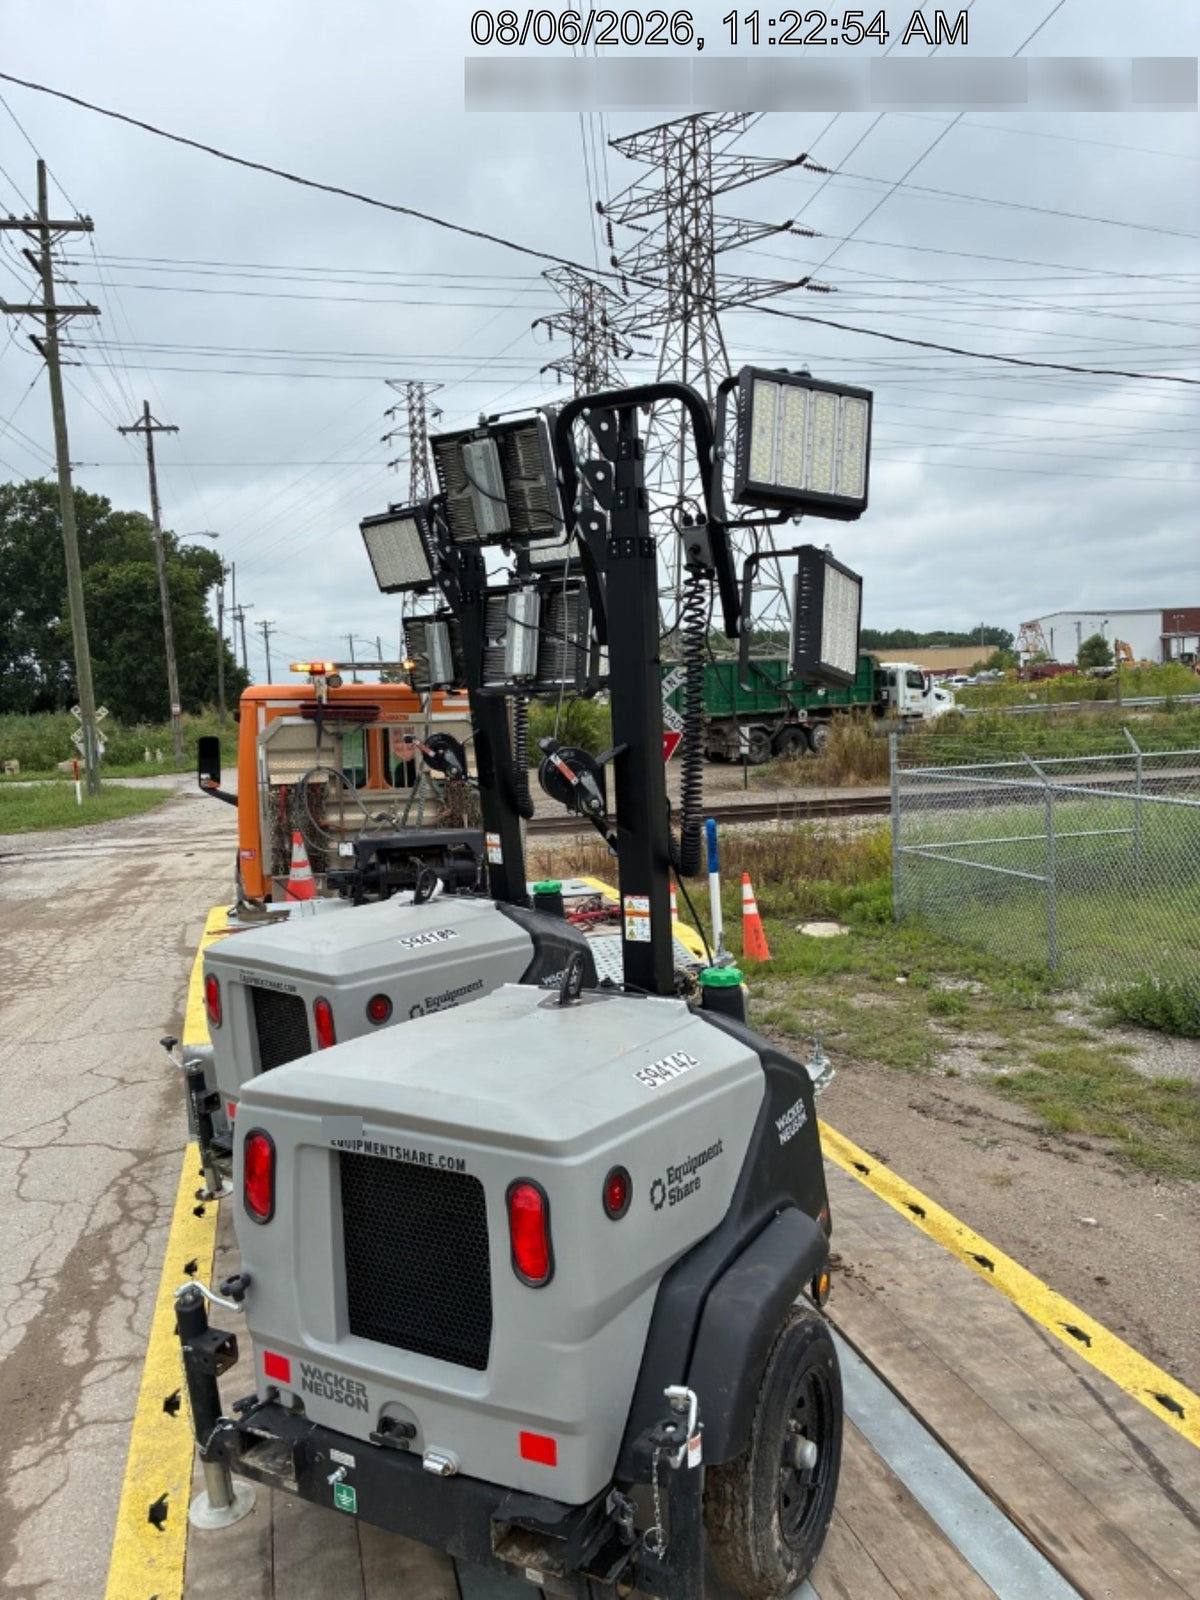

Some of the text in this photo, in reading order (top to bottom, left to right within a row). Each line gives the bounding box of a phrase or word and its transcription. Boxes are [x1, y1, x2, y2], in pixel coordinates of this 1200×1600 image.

[424, 978, 484, 1010] Equipment
[635, 1050, 699, 1088] 594142
[774, 1097, 805, 1132] WACKER
[779, 1108, 808, 1146] NEUSON
[666, 1138, 724, 1185] Equipment
[667, 1176, 702, 1207] Share
[300, 1362, 369, 1399] WACKER
[301, 1376, 369, 1414] NEUSON
